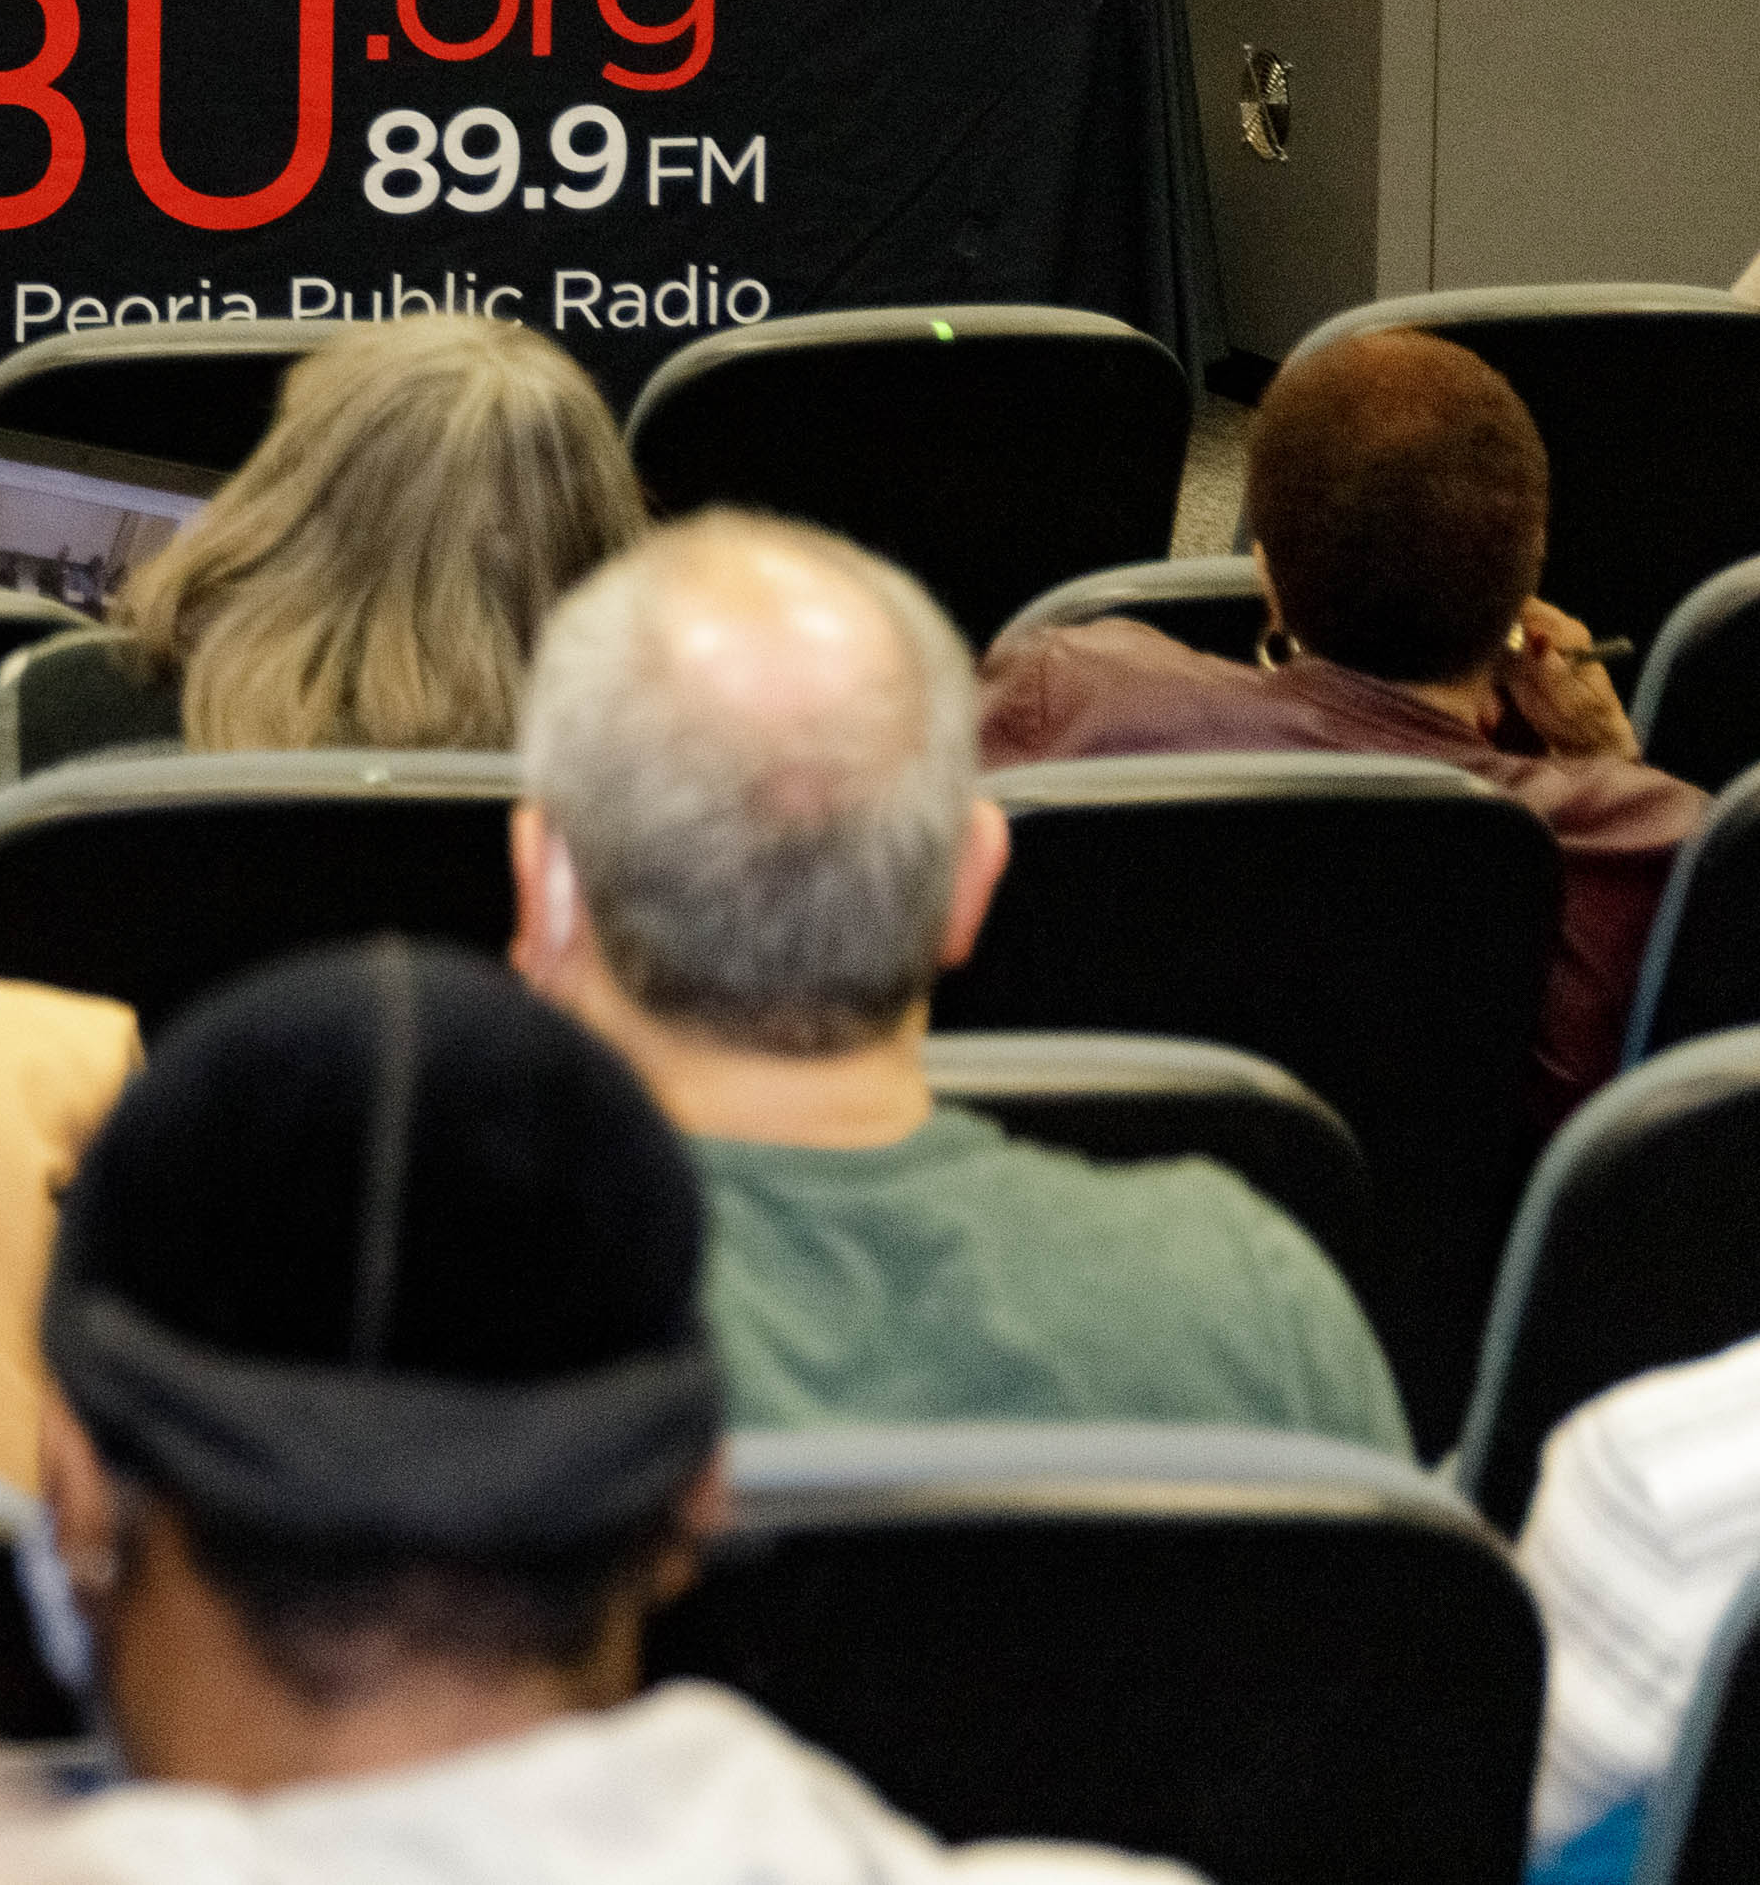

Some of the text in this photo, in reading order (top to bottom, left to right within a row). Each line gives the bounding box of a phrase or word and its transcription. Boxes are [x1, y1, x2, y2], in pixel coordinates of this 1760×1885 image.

[363, 104, 766, 214] 89.9 FM
[16, 279, 258, 343] Peoria
[555, 265, 771, 329] Radio
